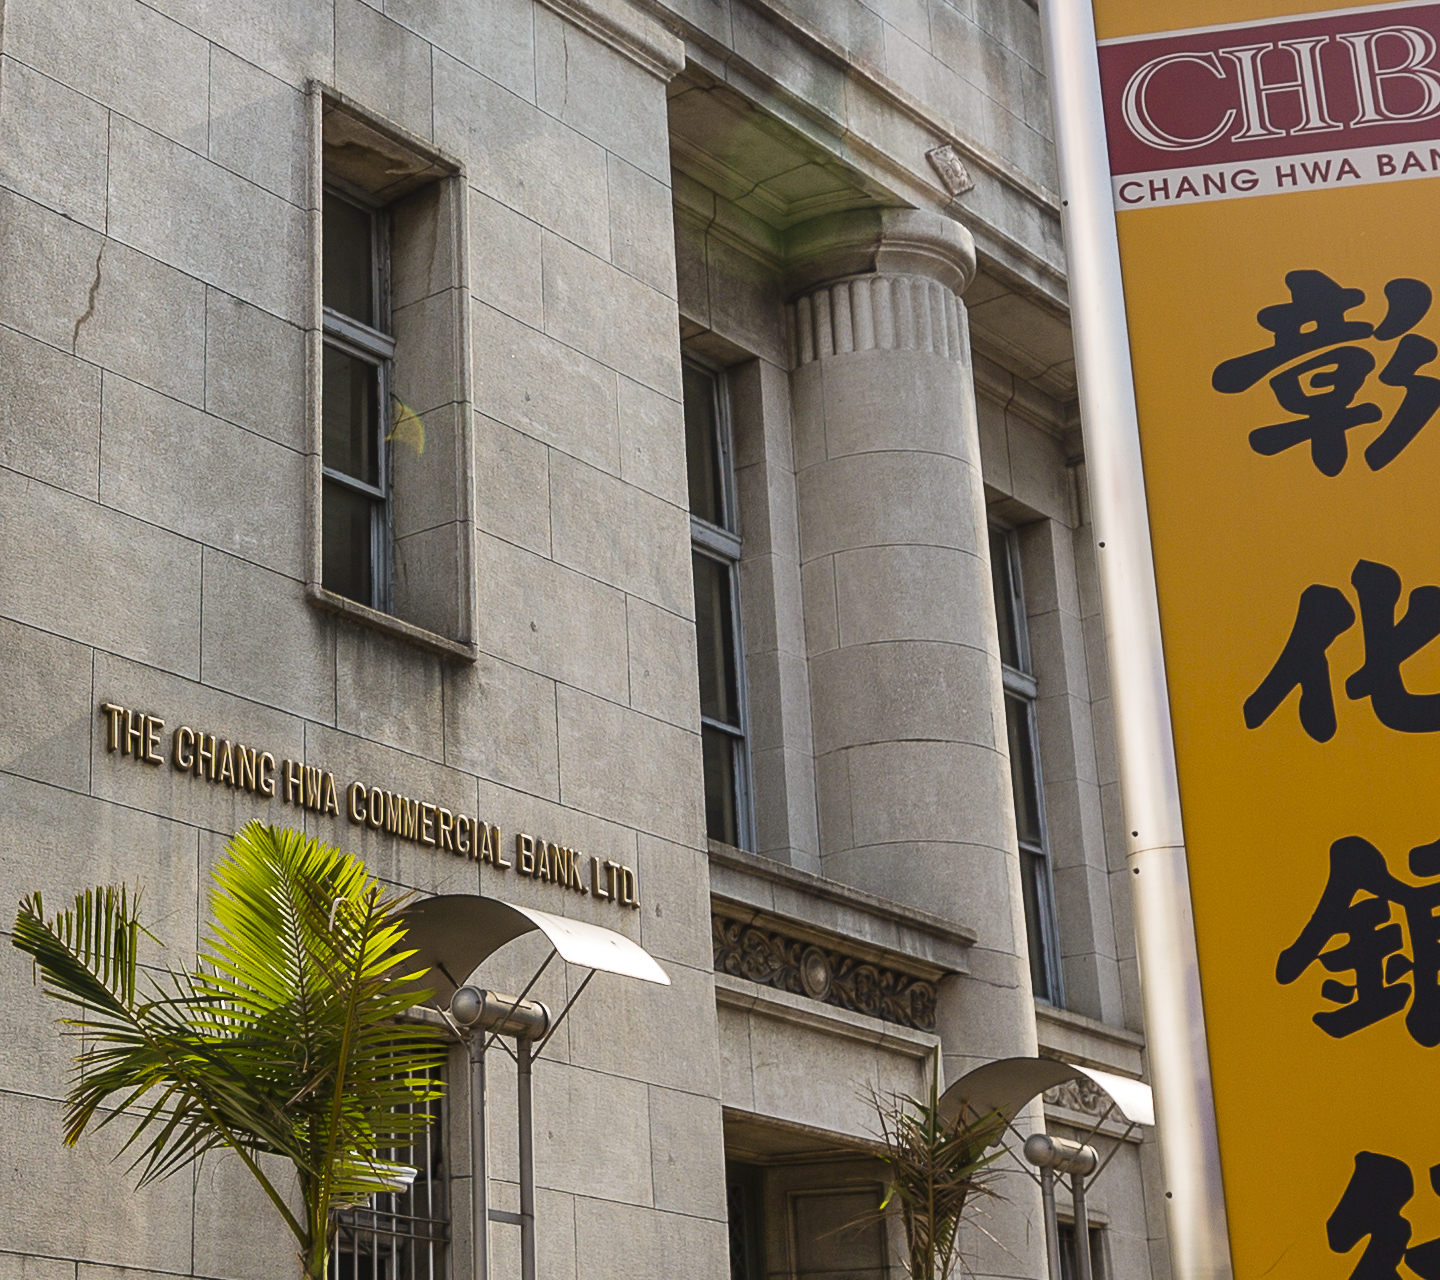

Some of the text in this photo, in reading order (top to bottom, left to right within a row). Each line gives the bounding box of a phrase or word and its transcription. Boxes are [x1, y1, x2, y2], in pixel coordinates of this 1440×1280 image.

[1118, 168, 1259, 204] CHANG
[1275, 157, 1361, 187] HWA
[101, 703, 165, 765] THE
[173, 725, 276, 797] CHANG
[282, 758, 340, 817] HWA
[347, 780, 513, 869] COMMERCIAL
[591, 856, 641, 909] LTD.
